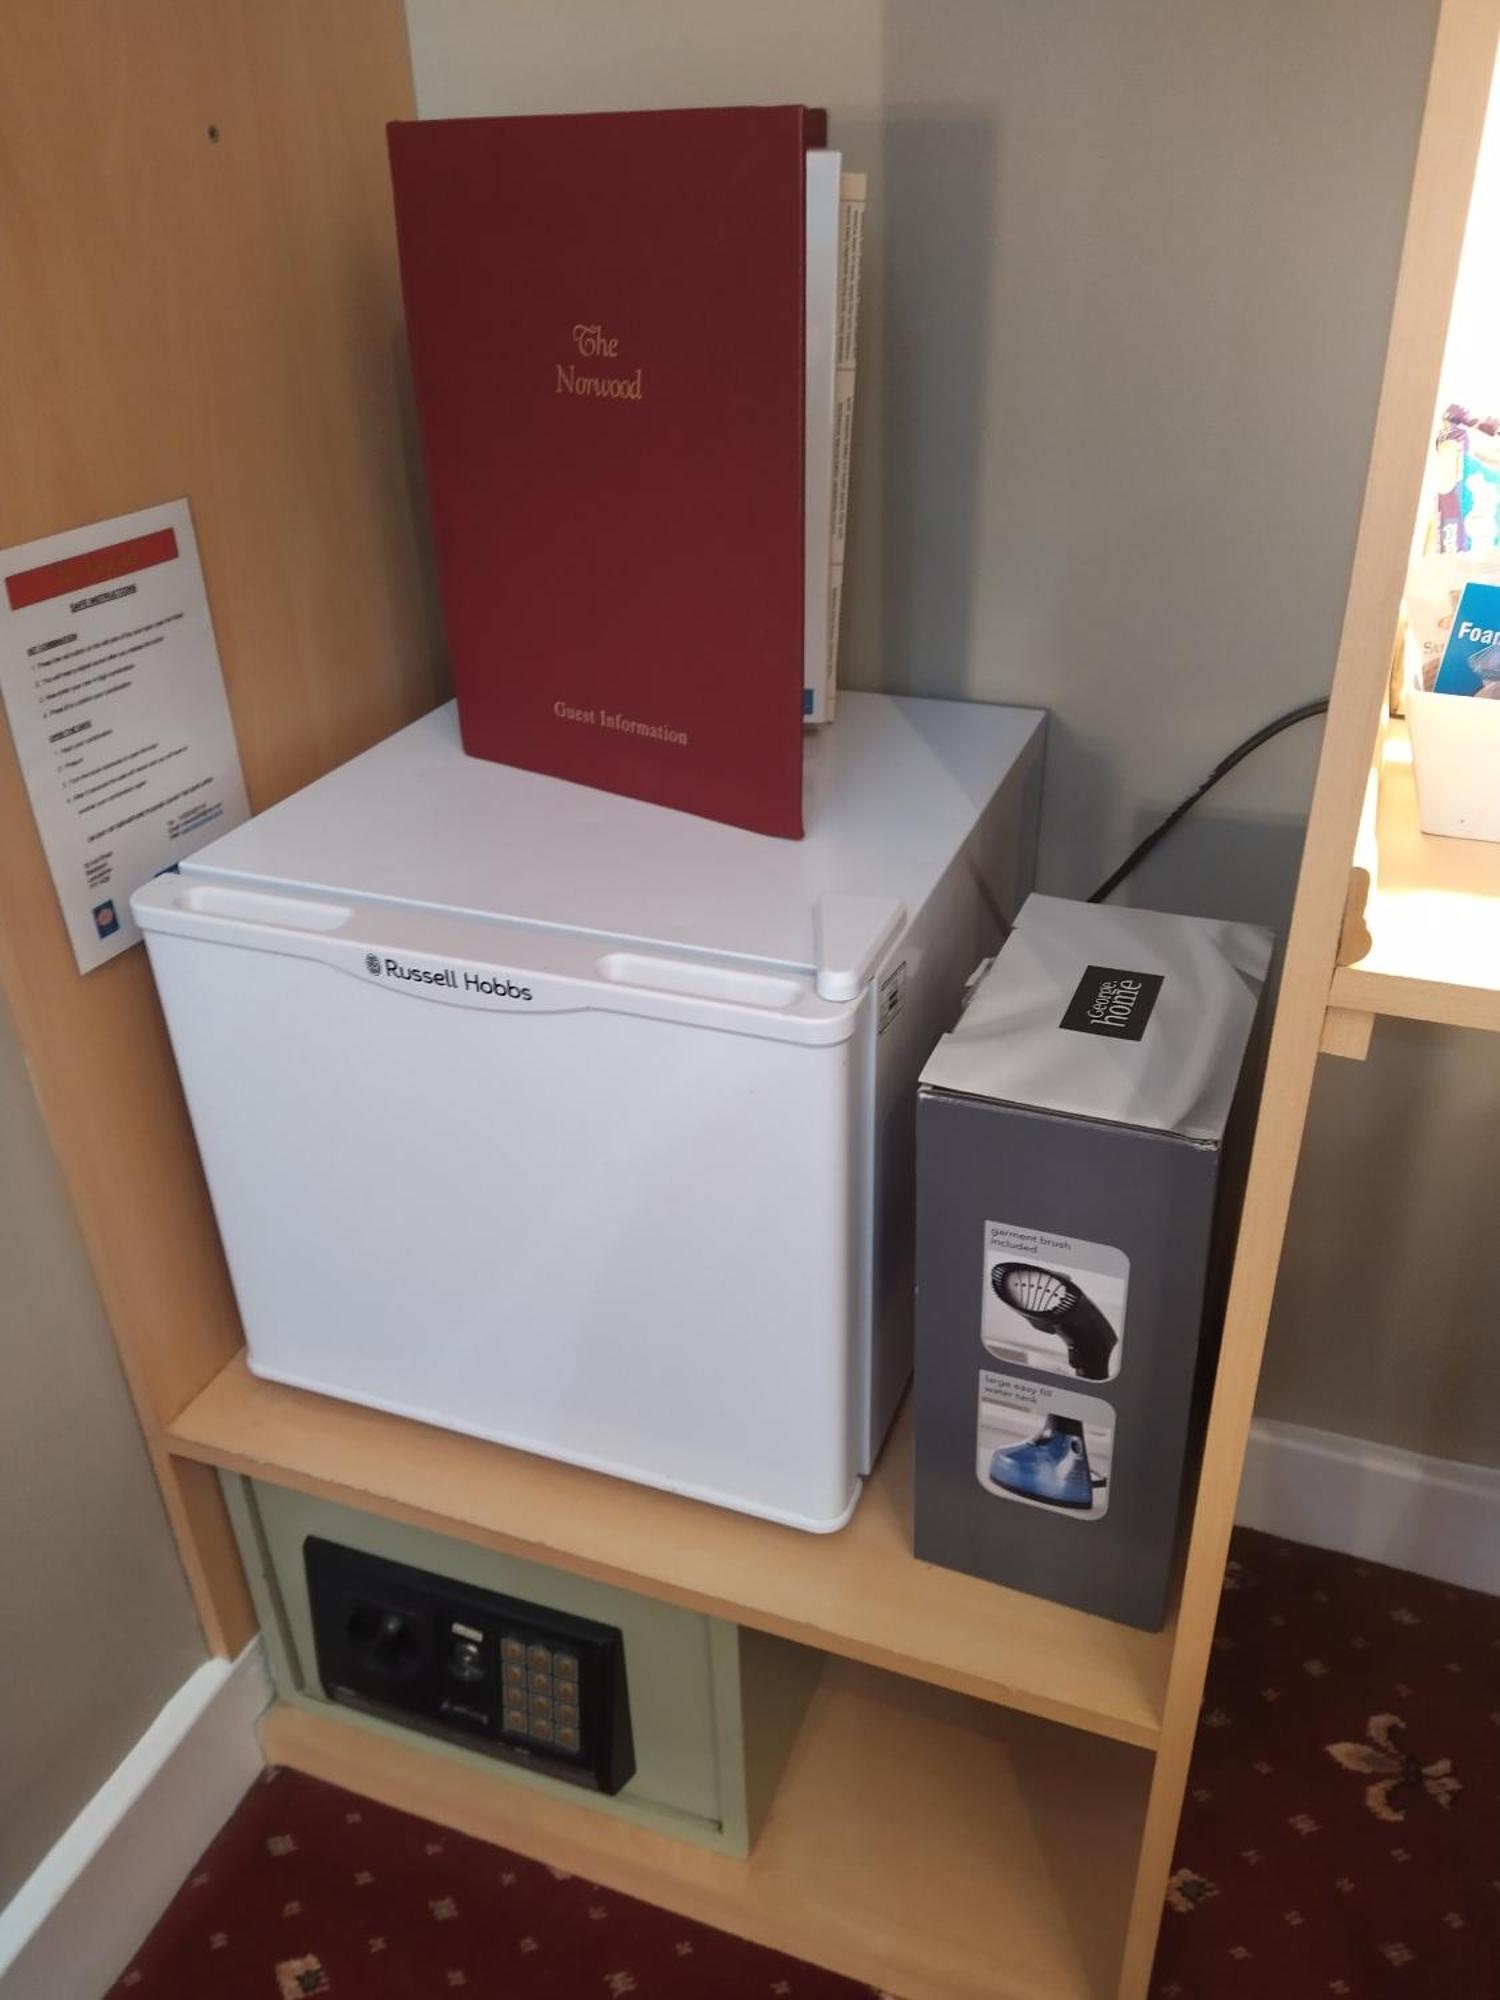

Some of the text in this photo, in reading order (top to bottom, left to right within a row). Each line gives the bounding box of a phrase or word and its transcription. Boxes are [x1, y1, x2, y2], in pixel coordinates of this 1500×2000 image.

[573, 324, 619, 357] The
[555, 364, 642, 400] Norwood
[554, 701, 688, 745] Guest Information
[384, 958, 533, 1001] Russell Hobbs
[1090, 980, 1142, 1027] home
[991, 1228, 1072, 1251] garment brush
[991, 1239, 1038, 1254] included
[985, 1374, 1011, 1389] large
